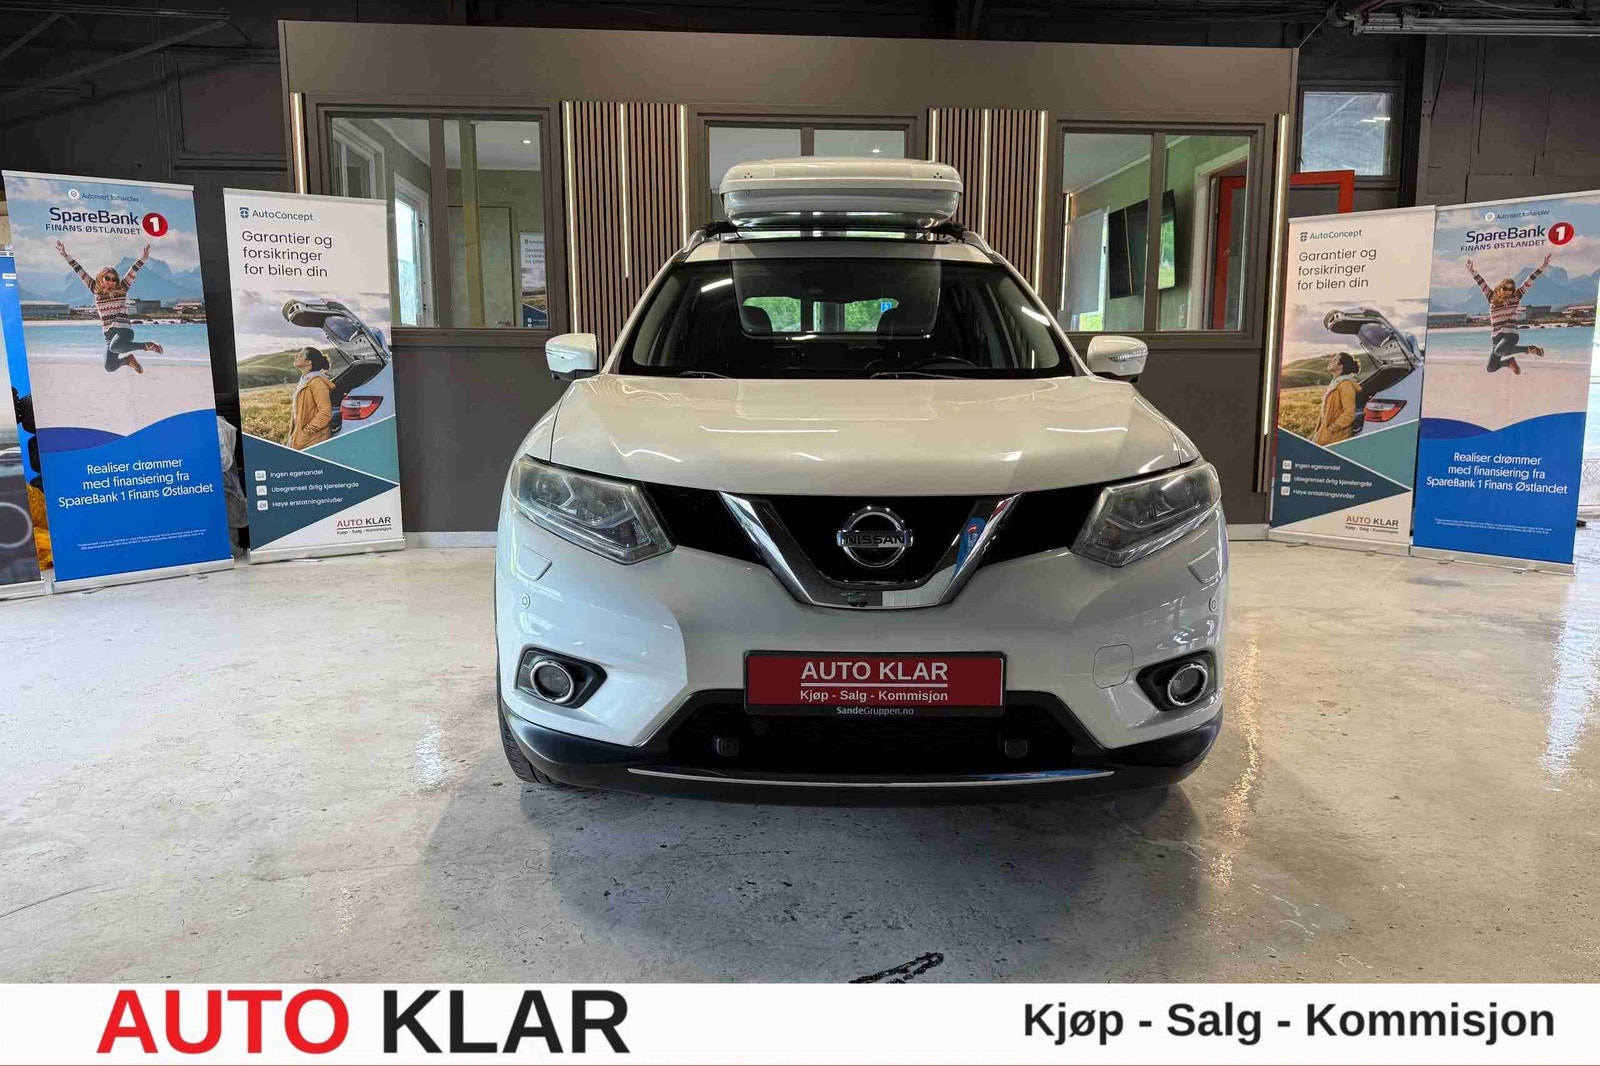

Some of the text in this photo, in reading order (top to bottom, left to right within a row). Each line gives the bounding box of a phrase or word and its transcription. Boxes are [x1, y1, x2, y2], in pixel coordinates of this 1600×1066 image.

[49, 207, 139, 225] SpareBank
[252, 210, 313, 221] AutoConcept
[46, 224, 141, 235] FINANS ØSTLANDET
[1310, 230, 1362, 240] AutoConcept
[1466, 225, 1546, 244] SpareBank
[242, 231, 332, 249] Garantier og
[1461, 240, 1546, 252] FINANS ØSTLANDET
[243, 247, 322, 263] forsikringer
[1299, 249, 1377, 261] Garantier og
[244, 263, 327, 277] for bilen din
[1299, 264, 1366, 276] forsikringer
[1298, 277, 1368, 290] for bilen din
[1454, 452, 1541, 465] Realiser drømmer
[87, 459, 183, 475] Realiser drømmer
[1448, 465, 1545, 480] med finansiering fra
[83, 471, 189, 490] med finansiering fra
[270, 469, 323, 479] Ingen egenandel
[272, 481, 360, 493] Ubegrenset årlig kjørelengde
[1426, 477, 1568, 494] SpareBank 1 Finans Østlandet
[59, 483, 213, 508] SpareBank 1 Finans Østlandet
[337, 516, 391, 528] AUTO KLAR
[1346, 516, 1398, 527] AUTO KLAR
[846, 534, 904, 545] NISSAN
[801, 661, 948, 680] AUTO KLAR
[800, 690, 829, 702] Kjøp
[840, 690, 867, 702] Salg
[878, 691, 948, 703] Kommisjon
[836, 707, 914, 716] SandeGruppen.no
